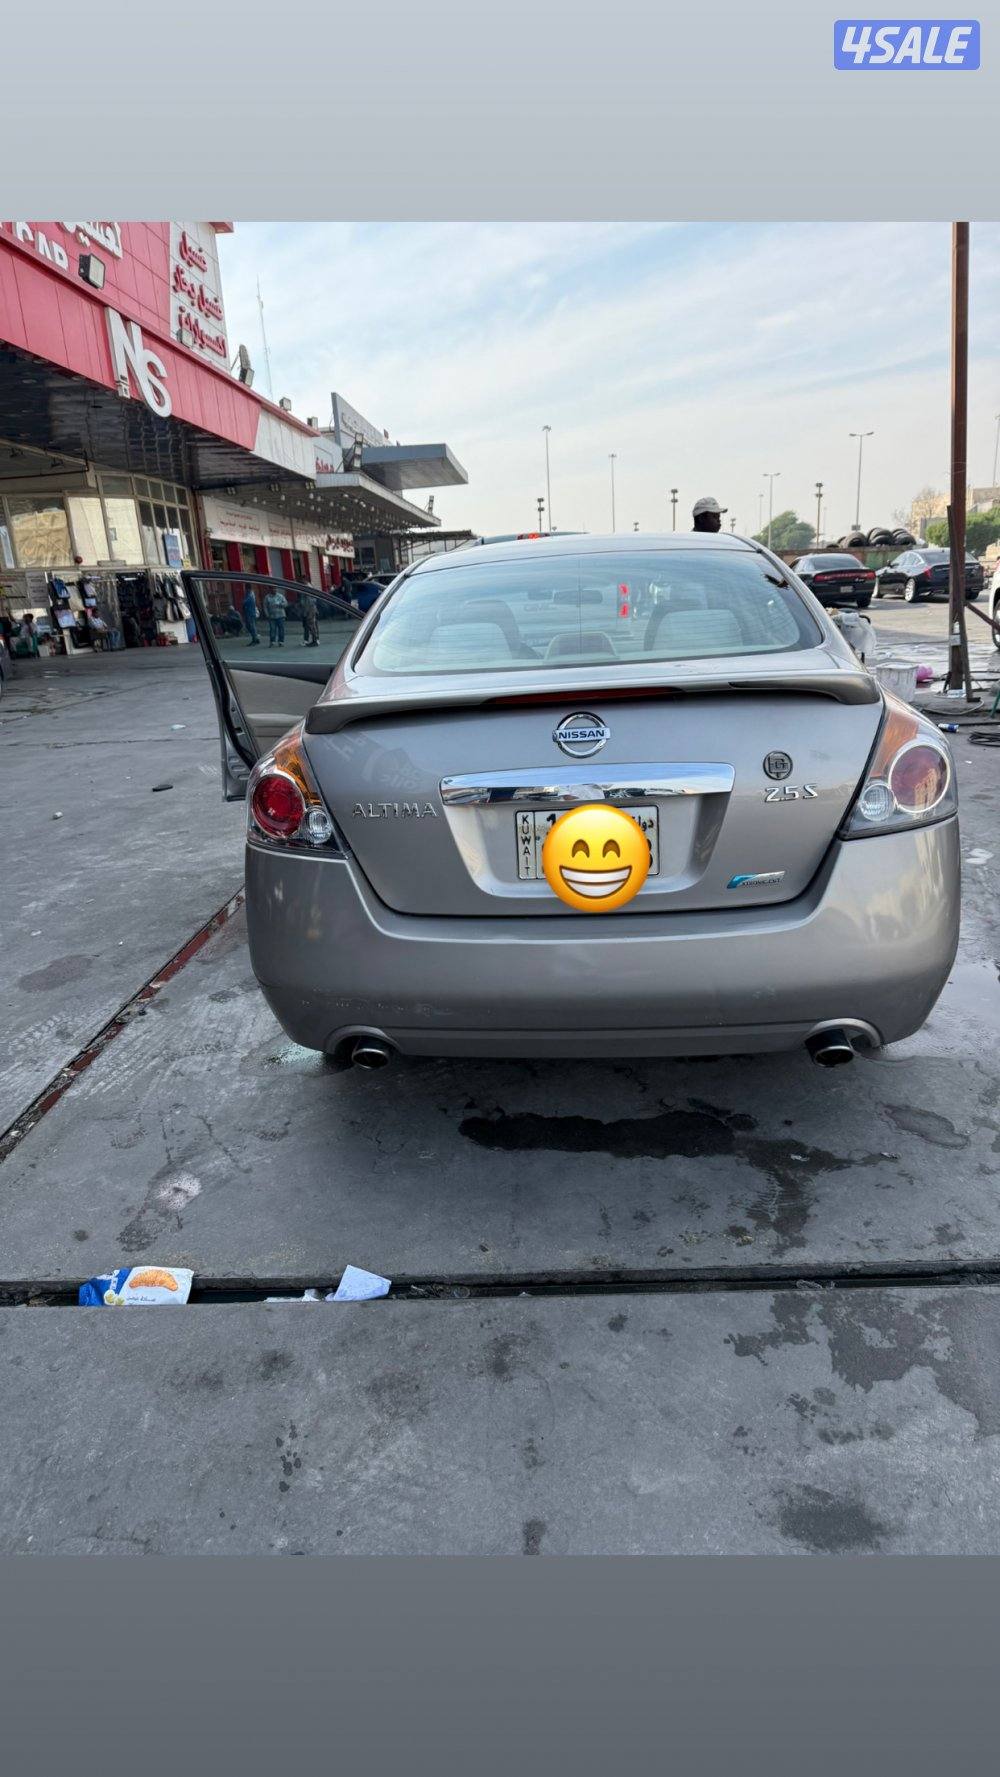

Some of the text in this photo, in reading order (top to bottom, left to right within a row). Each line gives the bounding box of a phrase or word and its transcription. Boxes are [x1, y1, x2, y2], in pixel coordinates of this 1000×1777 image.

[558, 729, 606, 740] NISSAN
[352, 802, 439, 818] ALTIMA
[521, 814, 532, 876] KUWAIT
